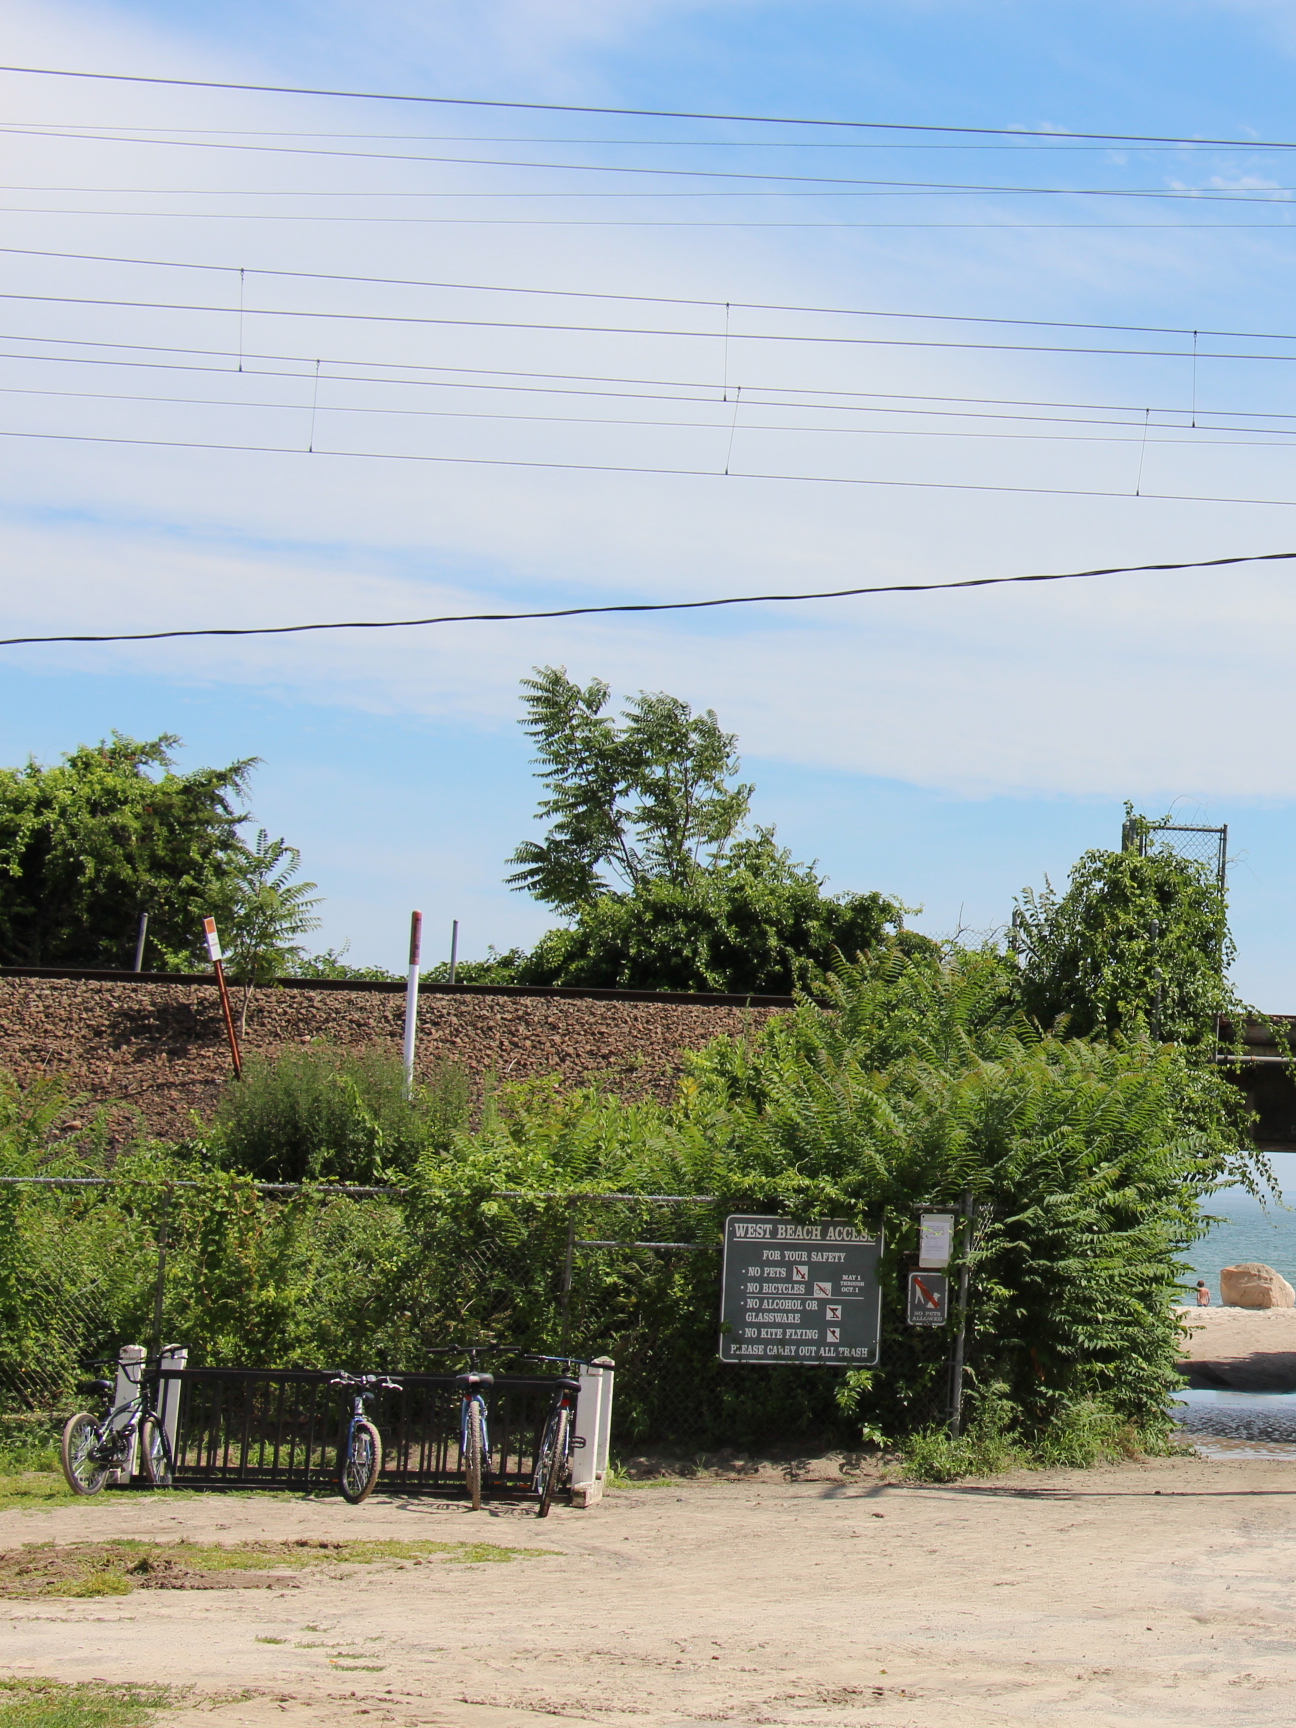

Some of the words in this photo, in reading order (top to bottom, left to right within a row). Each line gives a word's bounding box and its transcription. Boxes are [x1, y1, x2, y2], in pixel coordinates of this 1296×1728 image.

[734, 1223, 773, 1238] WEST
[776, 1224, 822, 1240] BEACH
[763, 1250, 780, 1260] FOR
[784, 1251, 808, 1261] YOUR
[811, 1252, 846, 1262] SAFETY
[748, 1267, 760, 1276] NO
[764, 1267, 786, 1277] PETS
[746, 1283, 759, 1292] NO
[762, 1283, 805, 1294] BICYCLES
[746, 1299, 759, 1308] NO
[762, 1299, 803, 1310] ALCOHOL
[806, 1300, 818, 1310] OR
[746, 1312, 800, 1323] GLASSWARE
[745, 1328, 757, 1338] NO
[761, 1328, 782, 1338] KITE
[786, 1329, 818, 1339] FLYING
[767, 1345, 796, 1356] CARRY
[799, 1346, 816, 1356] OUT
[819, 1347, 836, 1356] ALL
[839, 1347, 868, 1357] TRASH
